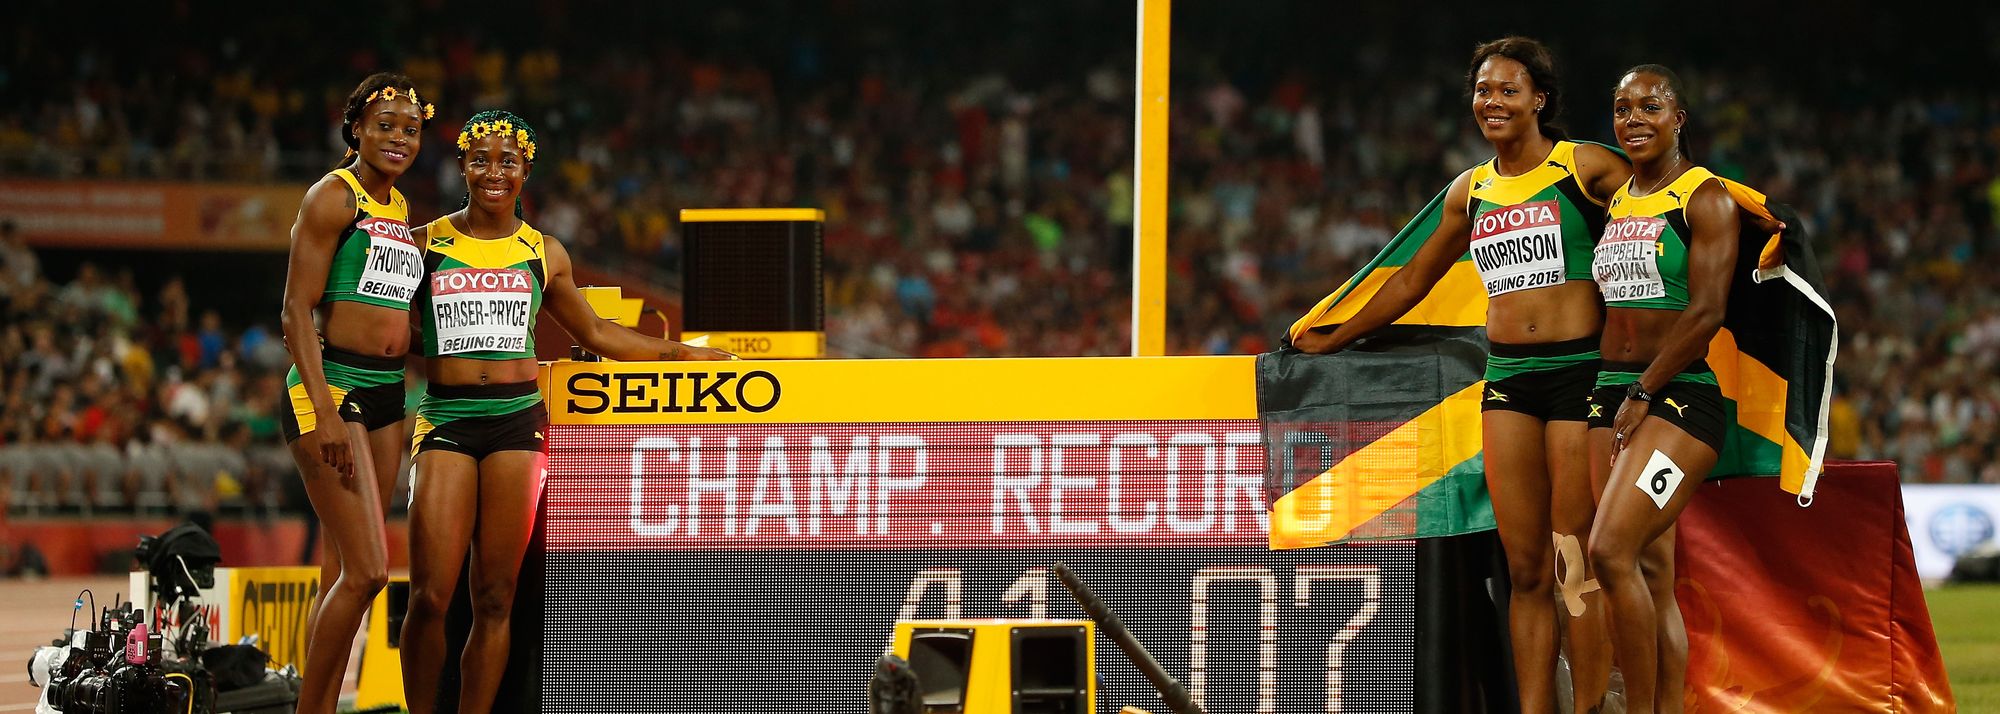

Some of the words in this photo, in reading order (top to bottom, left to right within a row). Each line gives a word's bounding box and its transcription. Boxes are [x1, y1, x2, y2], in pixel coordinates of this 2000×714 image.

[361, 221, 415, 242] TOYOTA
[1475, 205, 1555, 236] TOYOTA
[369, 245, 422, 280] THOMPSON
[1474, 233, 1558, 273] MORRISON
[436, 272, 529, 291] TOYOTA
[1487, 275, 1525, 295] BEIJING
[1528, 270, 1560, 287] 2015
[1597, 262, 1651, 282] BROWN
[362, 281, 405, 299] BEIJING
[1629, 283, 1659, 298] 2015
[436, 300, 528, 329] FRASER-PRYCE
[442, 336, 495, 352] BEIJING
[566, 370, 782, 414] SEIKO
[630, 434, 944, 537] CHAMP.
[1650, 467, 1674, 495] 6
